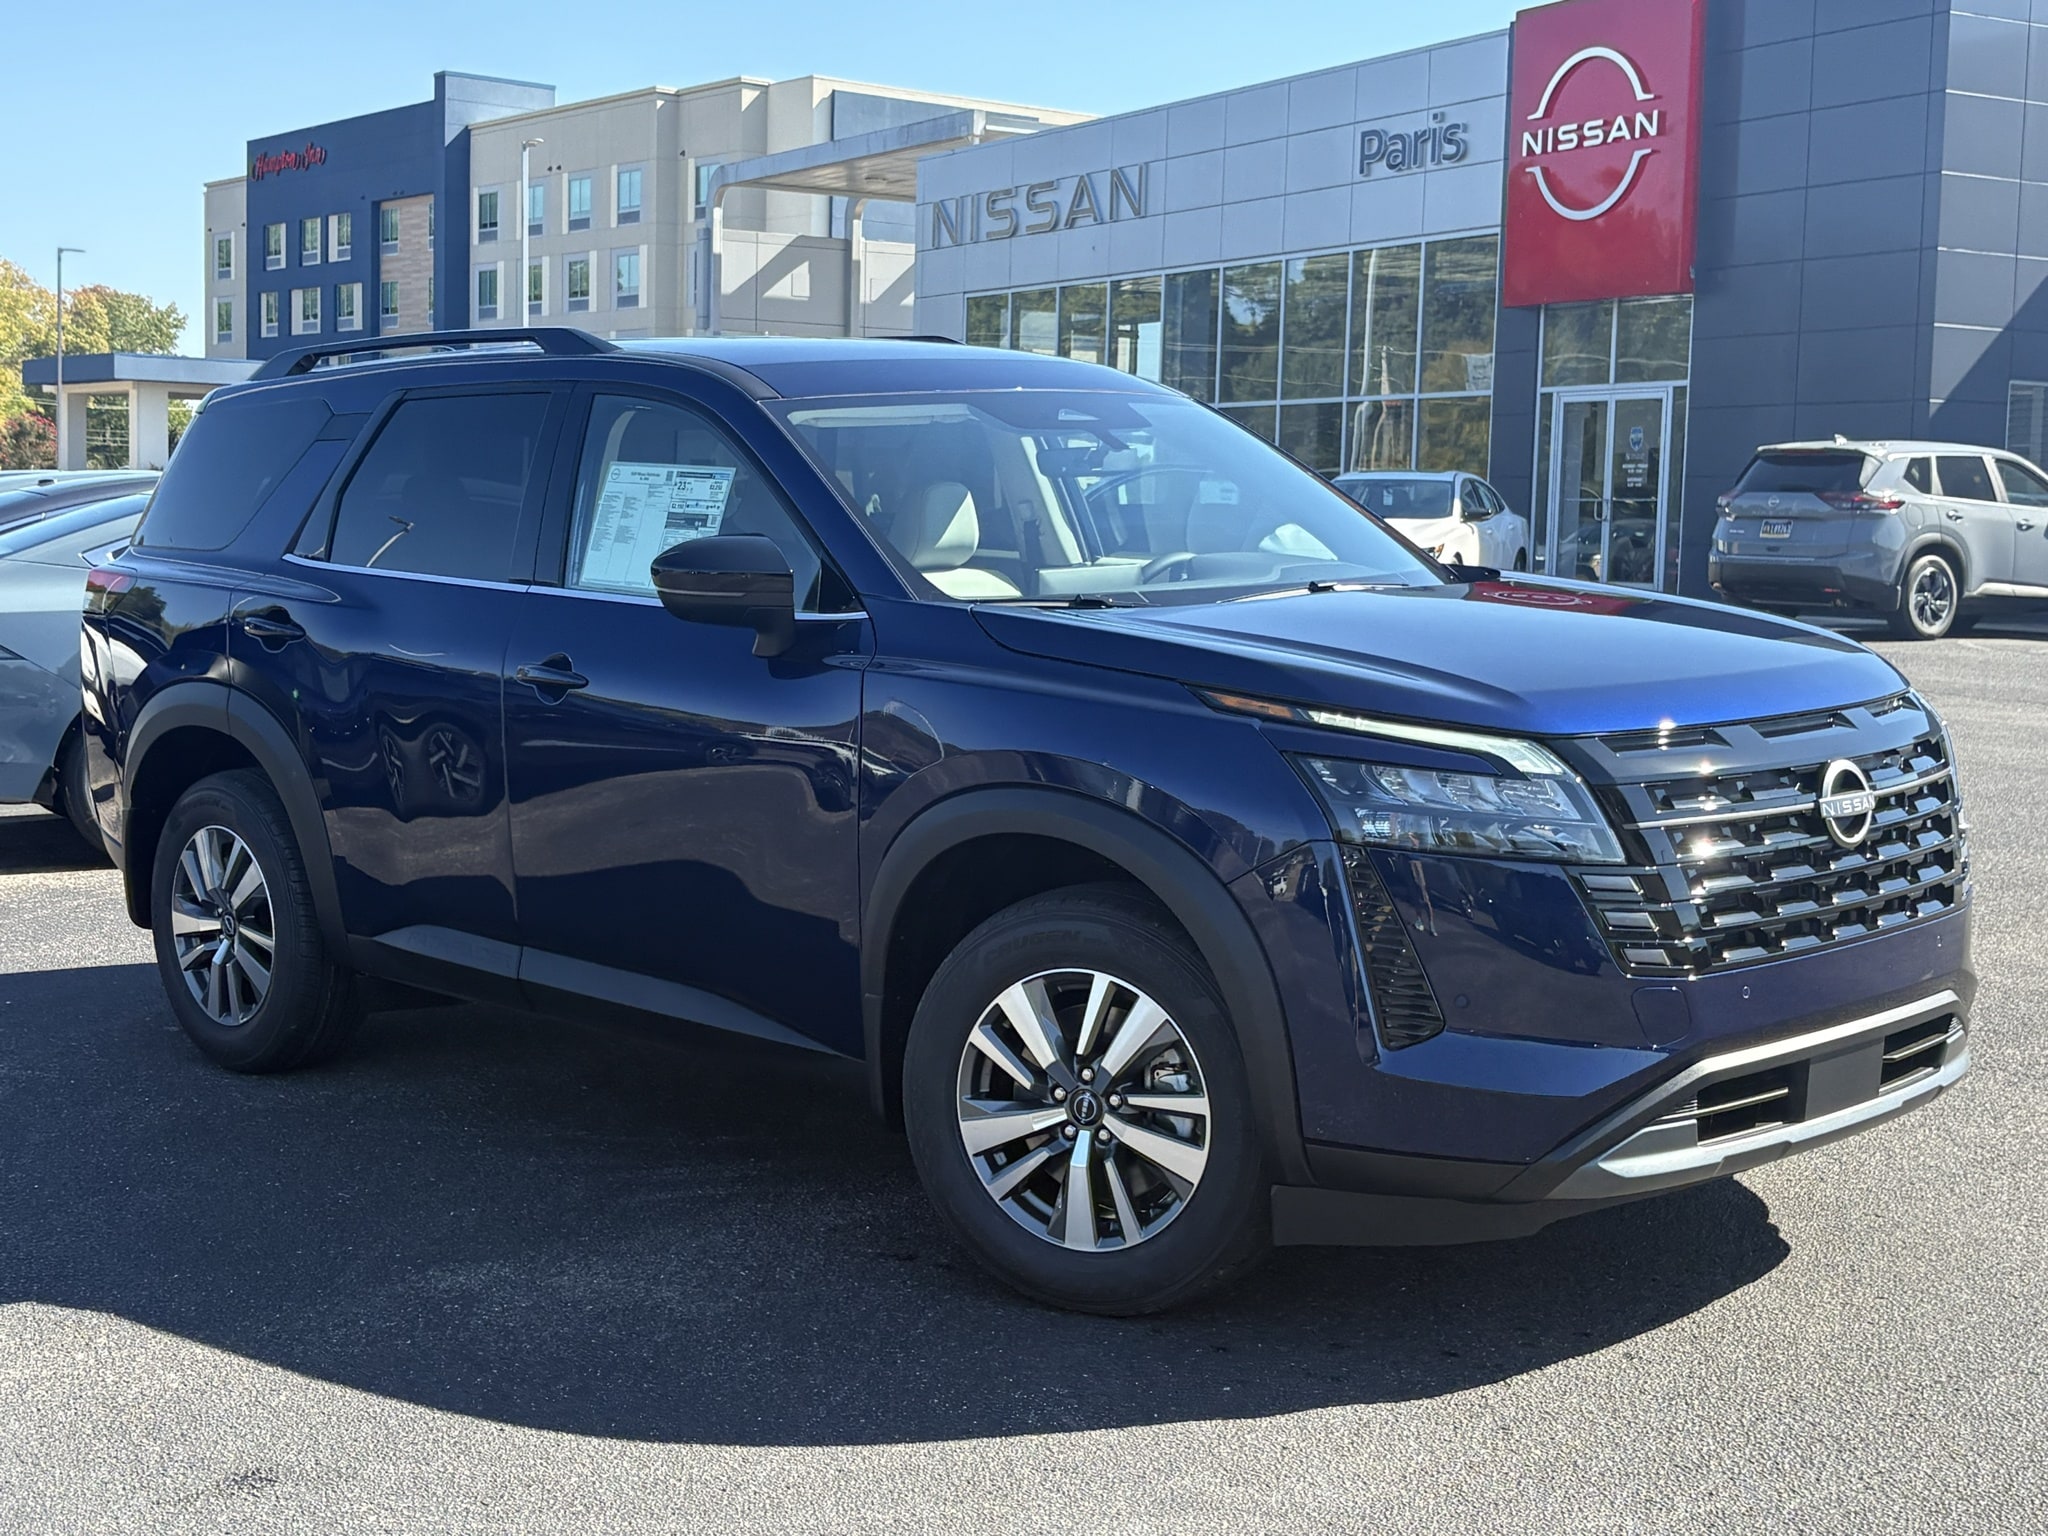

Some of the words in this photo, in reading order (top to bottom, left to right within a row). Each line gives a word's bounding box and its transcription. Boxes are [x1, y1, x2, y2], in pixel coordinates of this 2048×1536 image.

[1359, 111, 1466, 177] Paris
[1522, 109, 1659, 157] NISSAN
[251, 149, 300, 181] Hampton
[301, 142, 326, 169] Inn
[931, 162, 1148, 248] NISSAN
[677, 481, 687, 491] 23
[1820, 793, 1876, 816] NISSAN
